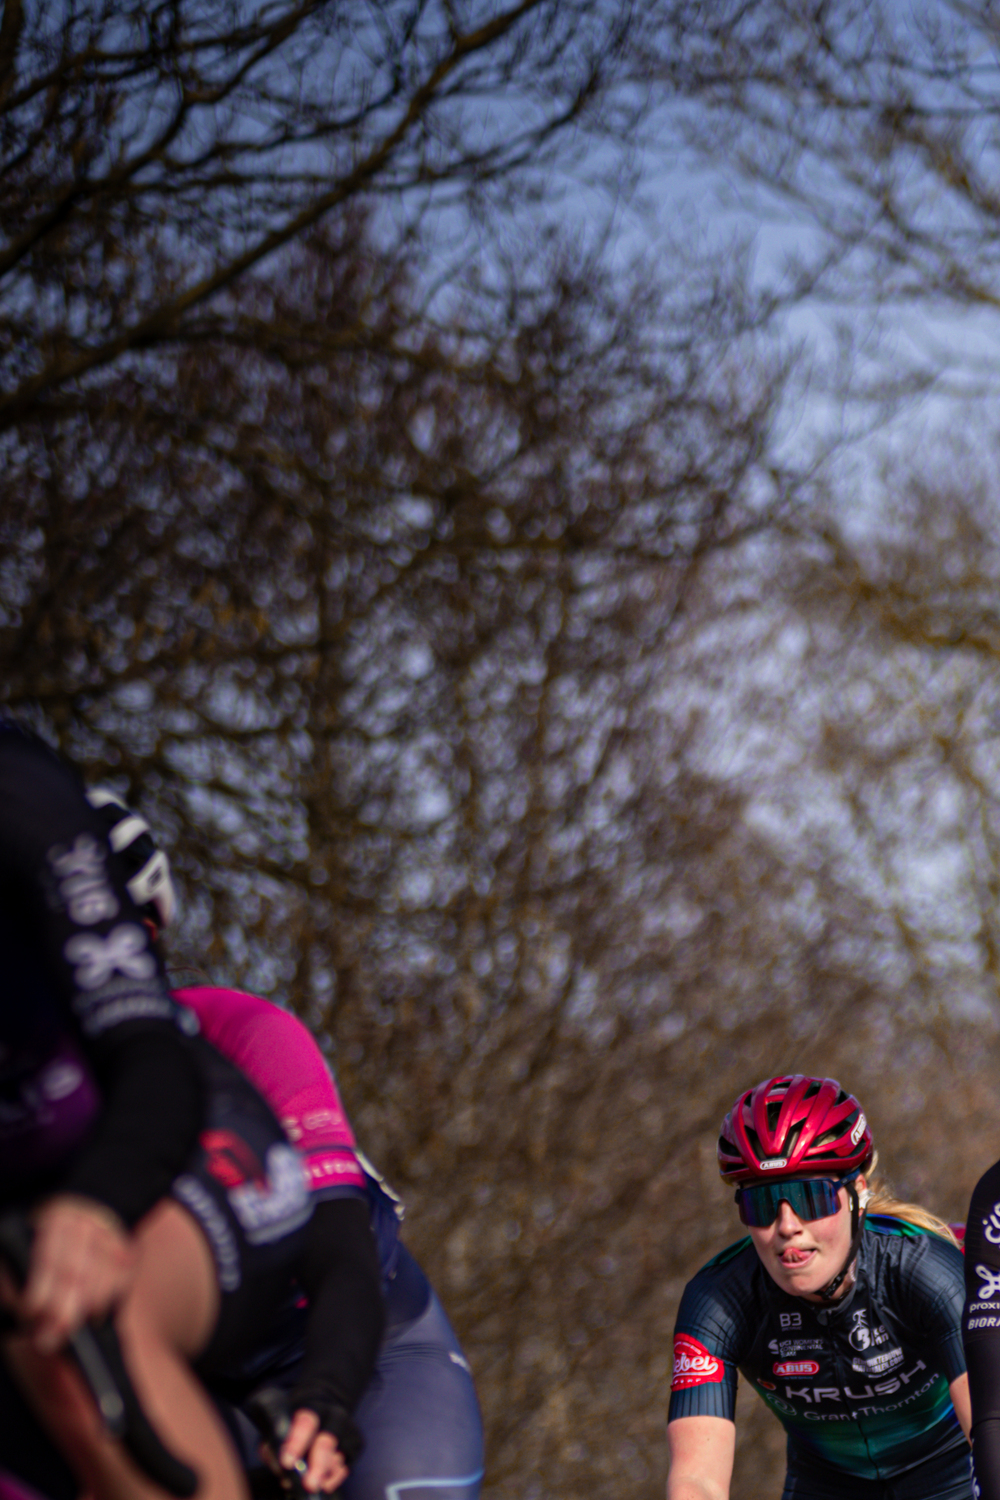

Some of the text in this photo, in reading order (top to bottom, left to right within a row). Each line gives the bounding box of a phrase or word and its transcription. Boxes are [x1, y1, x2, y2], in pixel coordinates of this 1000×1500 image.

[763, 1160, 785, 1169] ABUS
[779, 1312, 802, 1328] B3
[776, 1363, 813, 1374] ABUS
[784, 1359, 928, 1404] KRUSH
[803, 1372, 940, 1422] Grant Thornton
